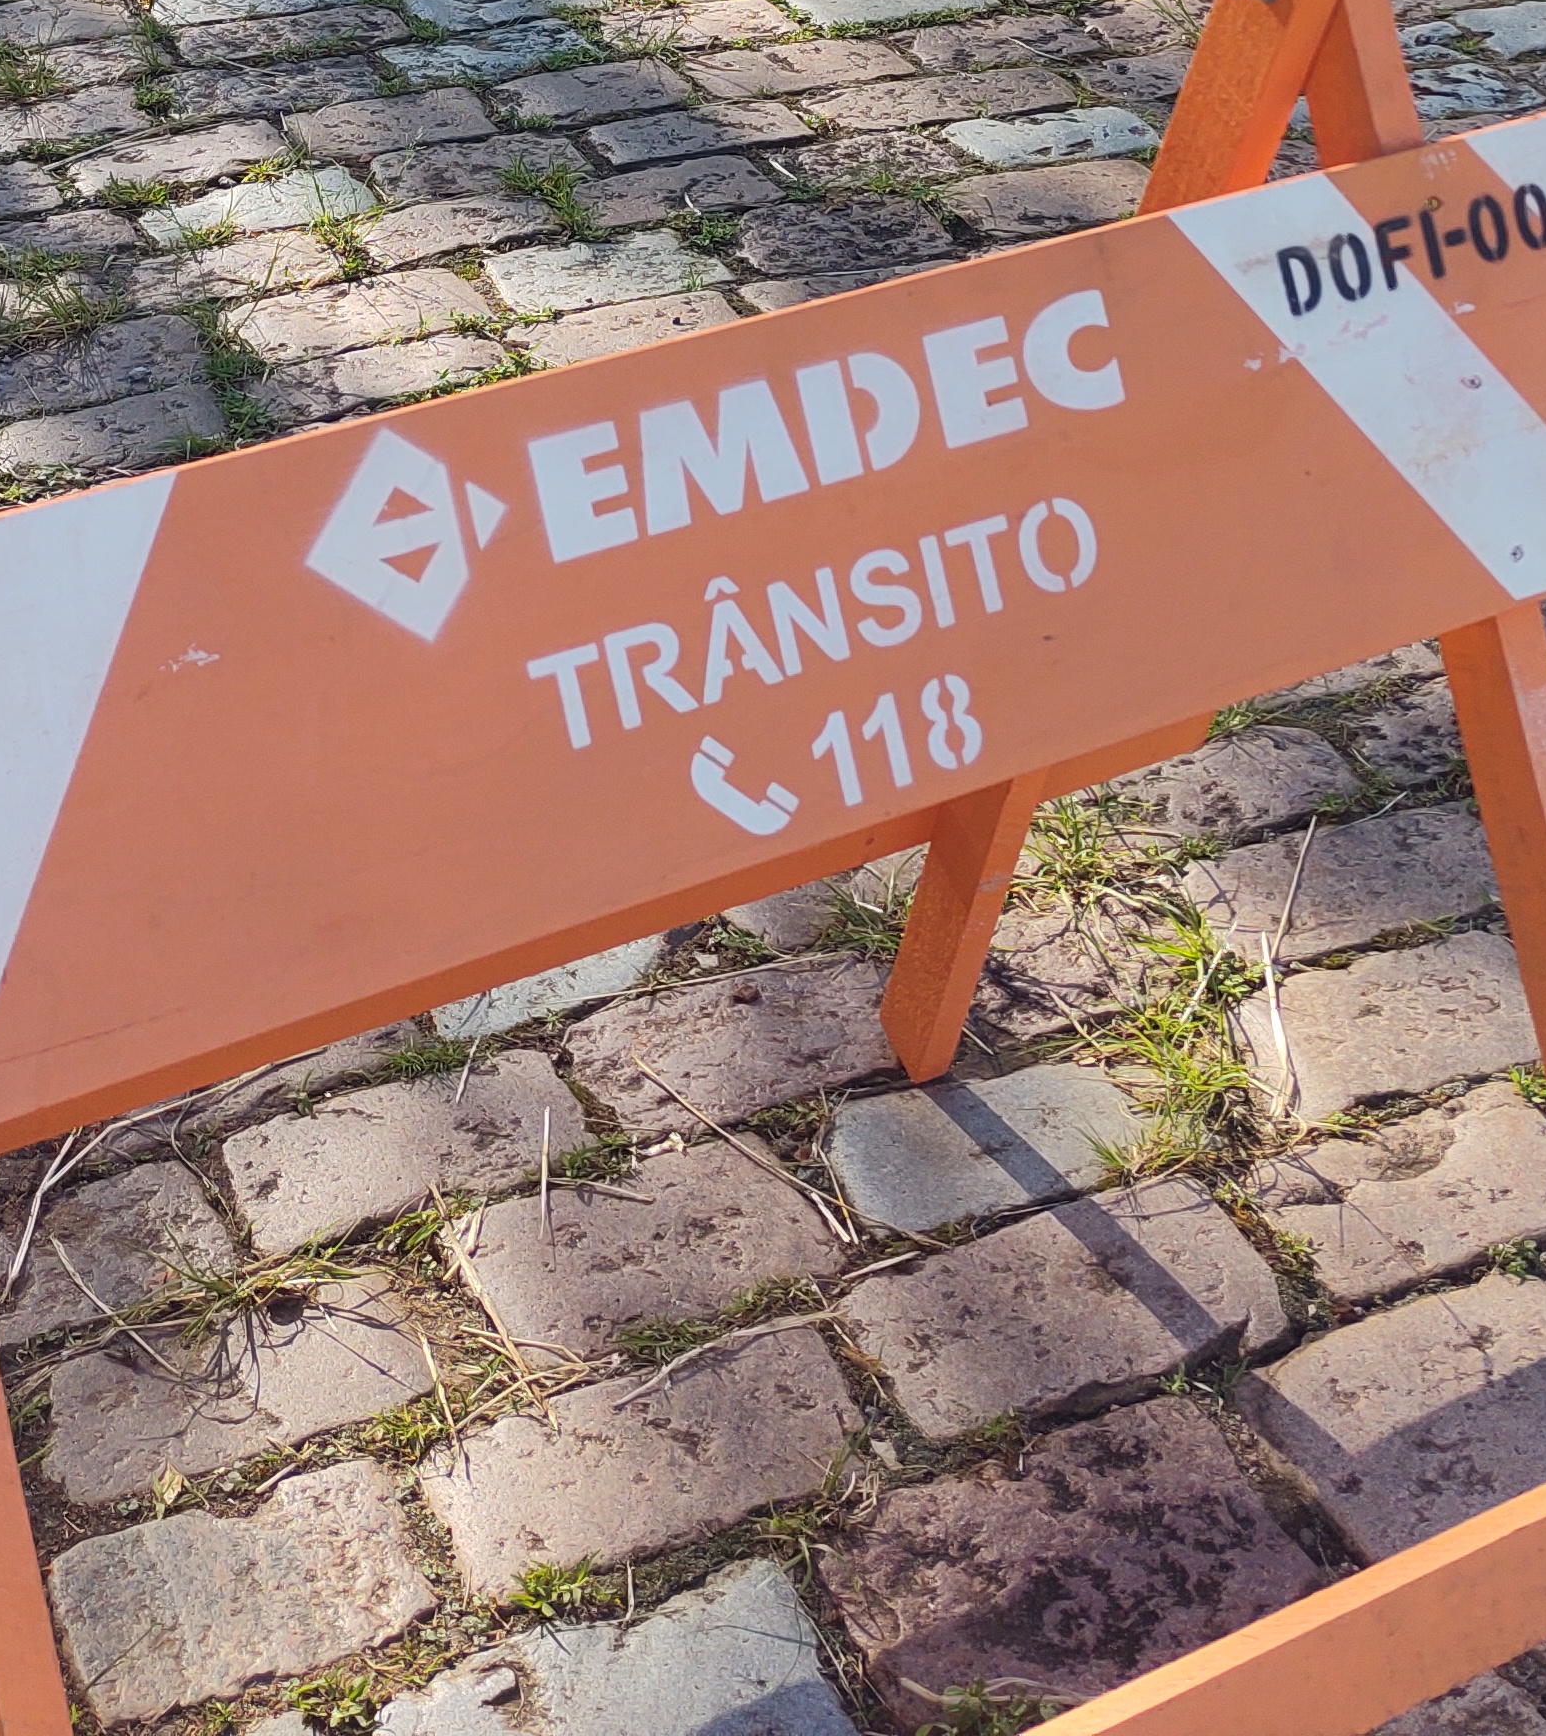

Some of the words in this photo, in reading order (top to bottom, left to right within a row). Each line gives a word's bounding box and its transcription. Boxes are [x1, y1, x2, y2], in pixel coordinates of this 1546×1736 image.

[527, 289, 1125, 563] EMDEC
[527, 496, 1099, 751] TRÂNSITO
[811, 672, 985, 808] 118
